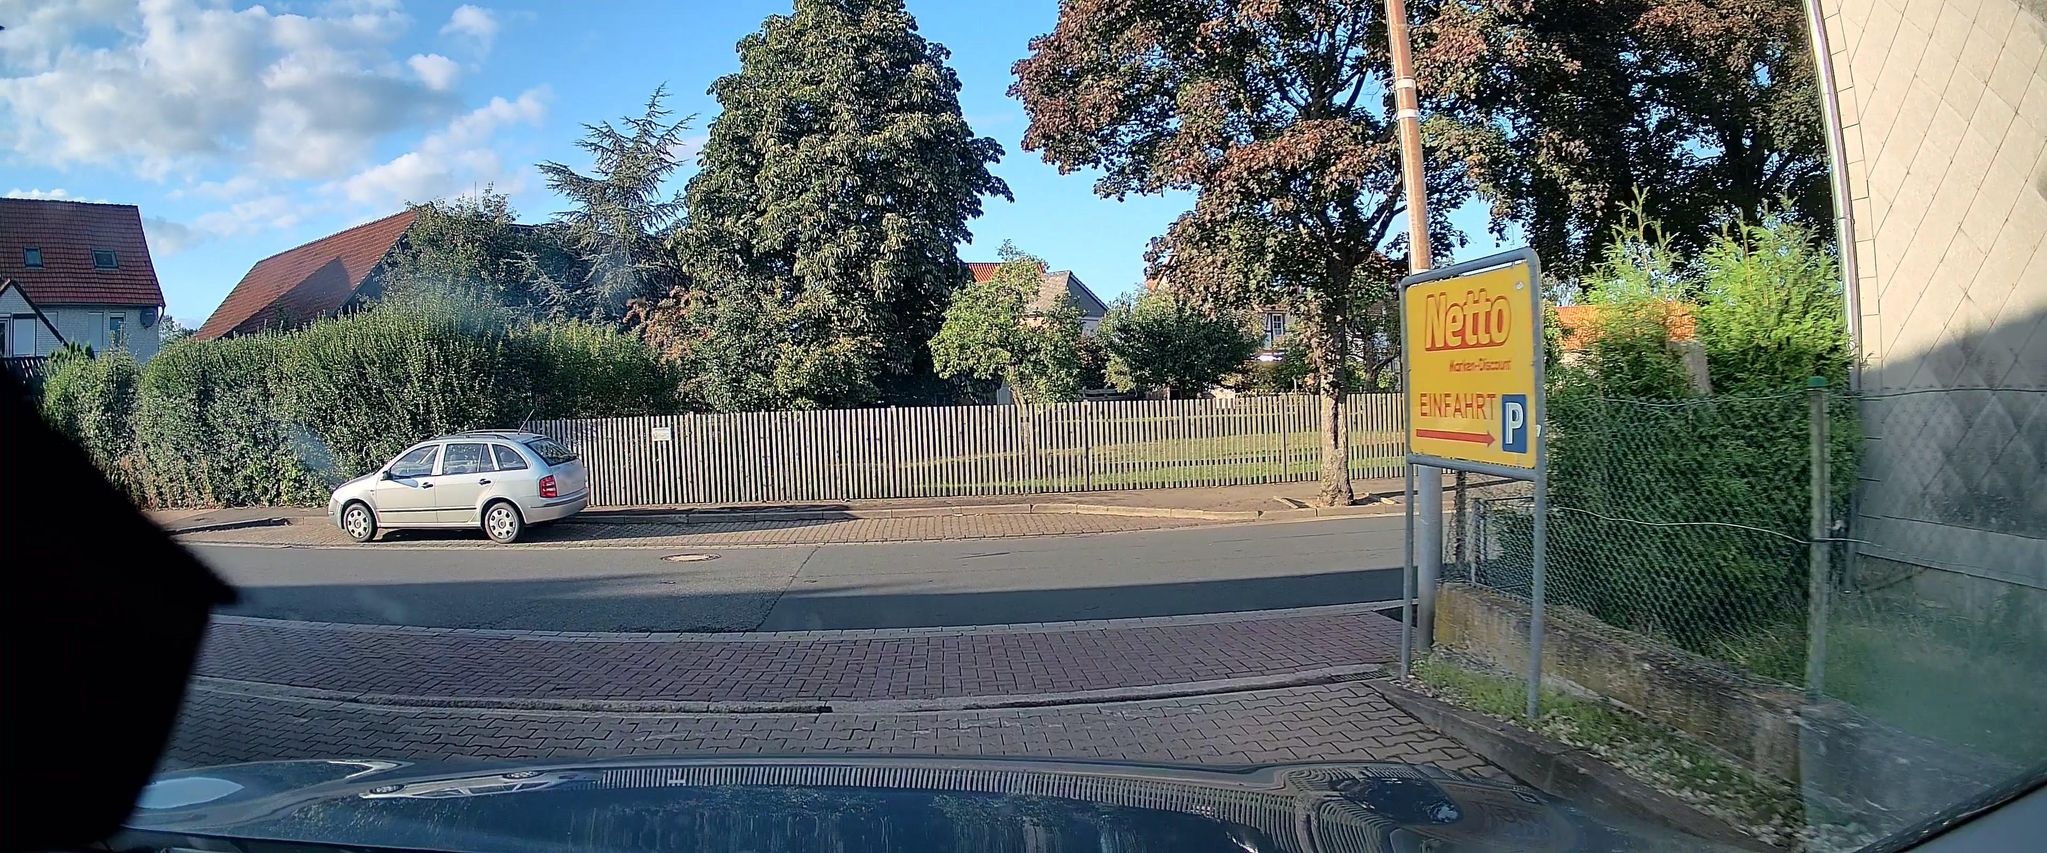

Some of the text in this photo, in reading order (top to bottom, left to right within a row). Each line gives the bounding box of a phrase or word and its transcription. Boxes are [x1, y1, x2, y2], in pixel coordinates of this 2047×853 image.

[1425, 288, 1512, 351] Netto
[1420, 393, 1498, 420] EINFAHRT
[1504, 402, 1525, 445] P
